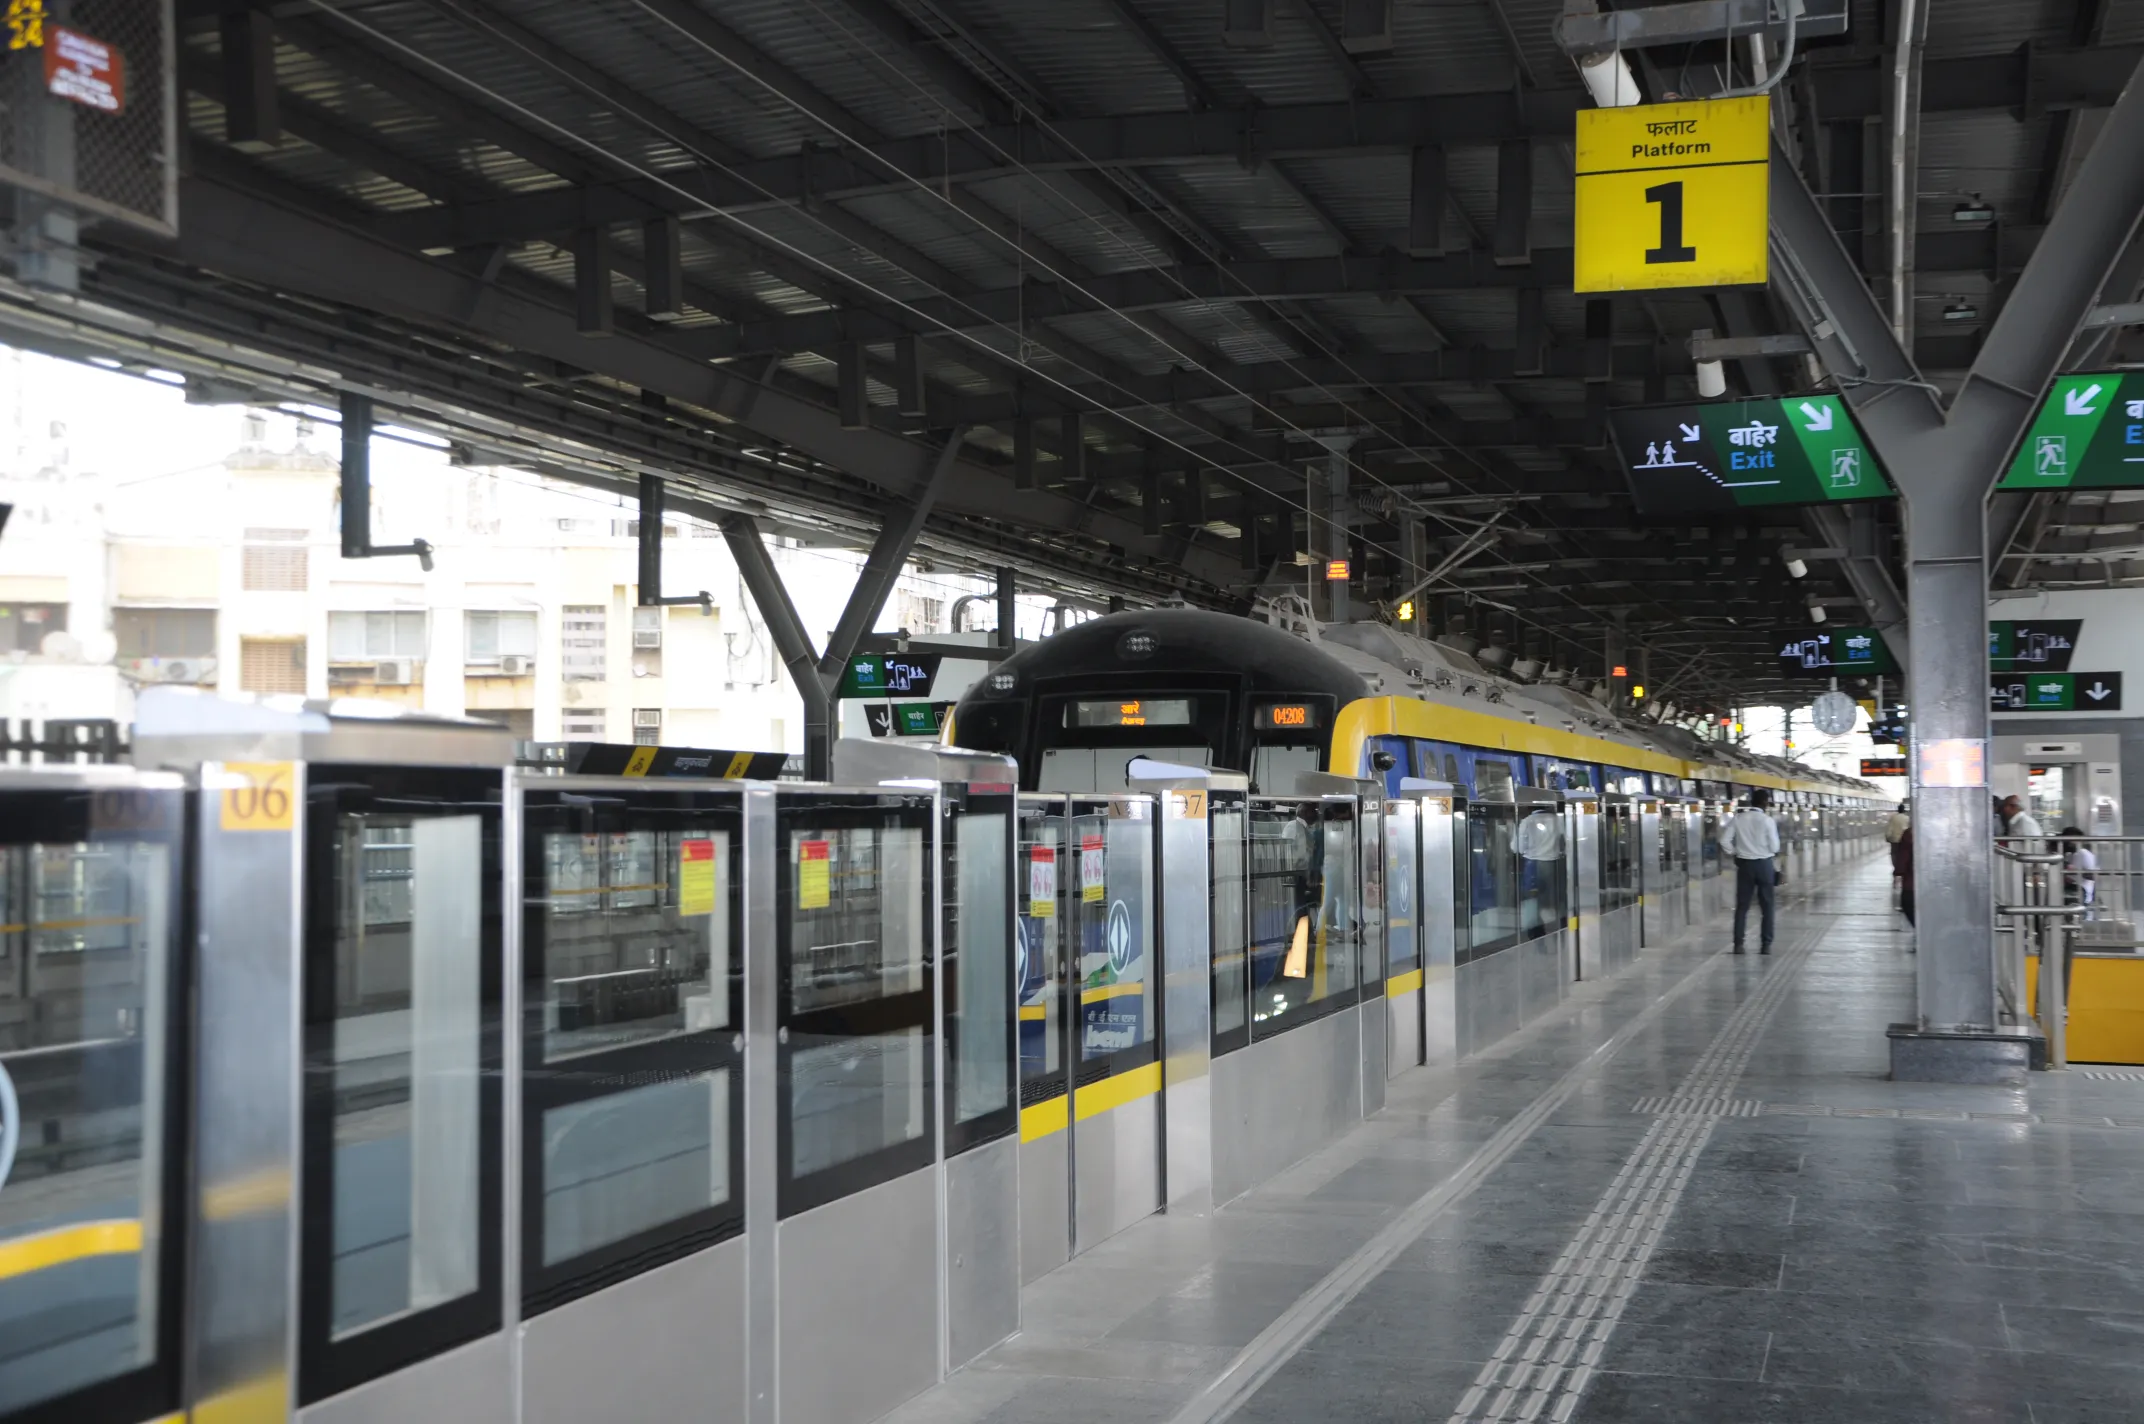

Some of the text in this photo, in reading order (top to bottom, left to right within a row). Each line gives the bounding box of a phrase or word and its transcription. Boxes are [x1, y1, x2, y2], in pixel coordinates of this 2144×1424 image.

[1646, 119, 1697, 136] फलाट
[1632, 141, 1711, 158] Platform
[1645, 181, 1696, 264] 1
[1728, 420, 1778, 448] बाहेर
[1730, 451, 1776, 470] Exit
[855, 662, 873, 674] बाहेर
[1273, 707, 1305, 724] 04208
[230, 771, 288, 820] 06
